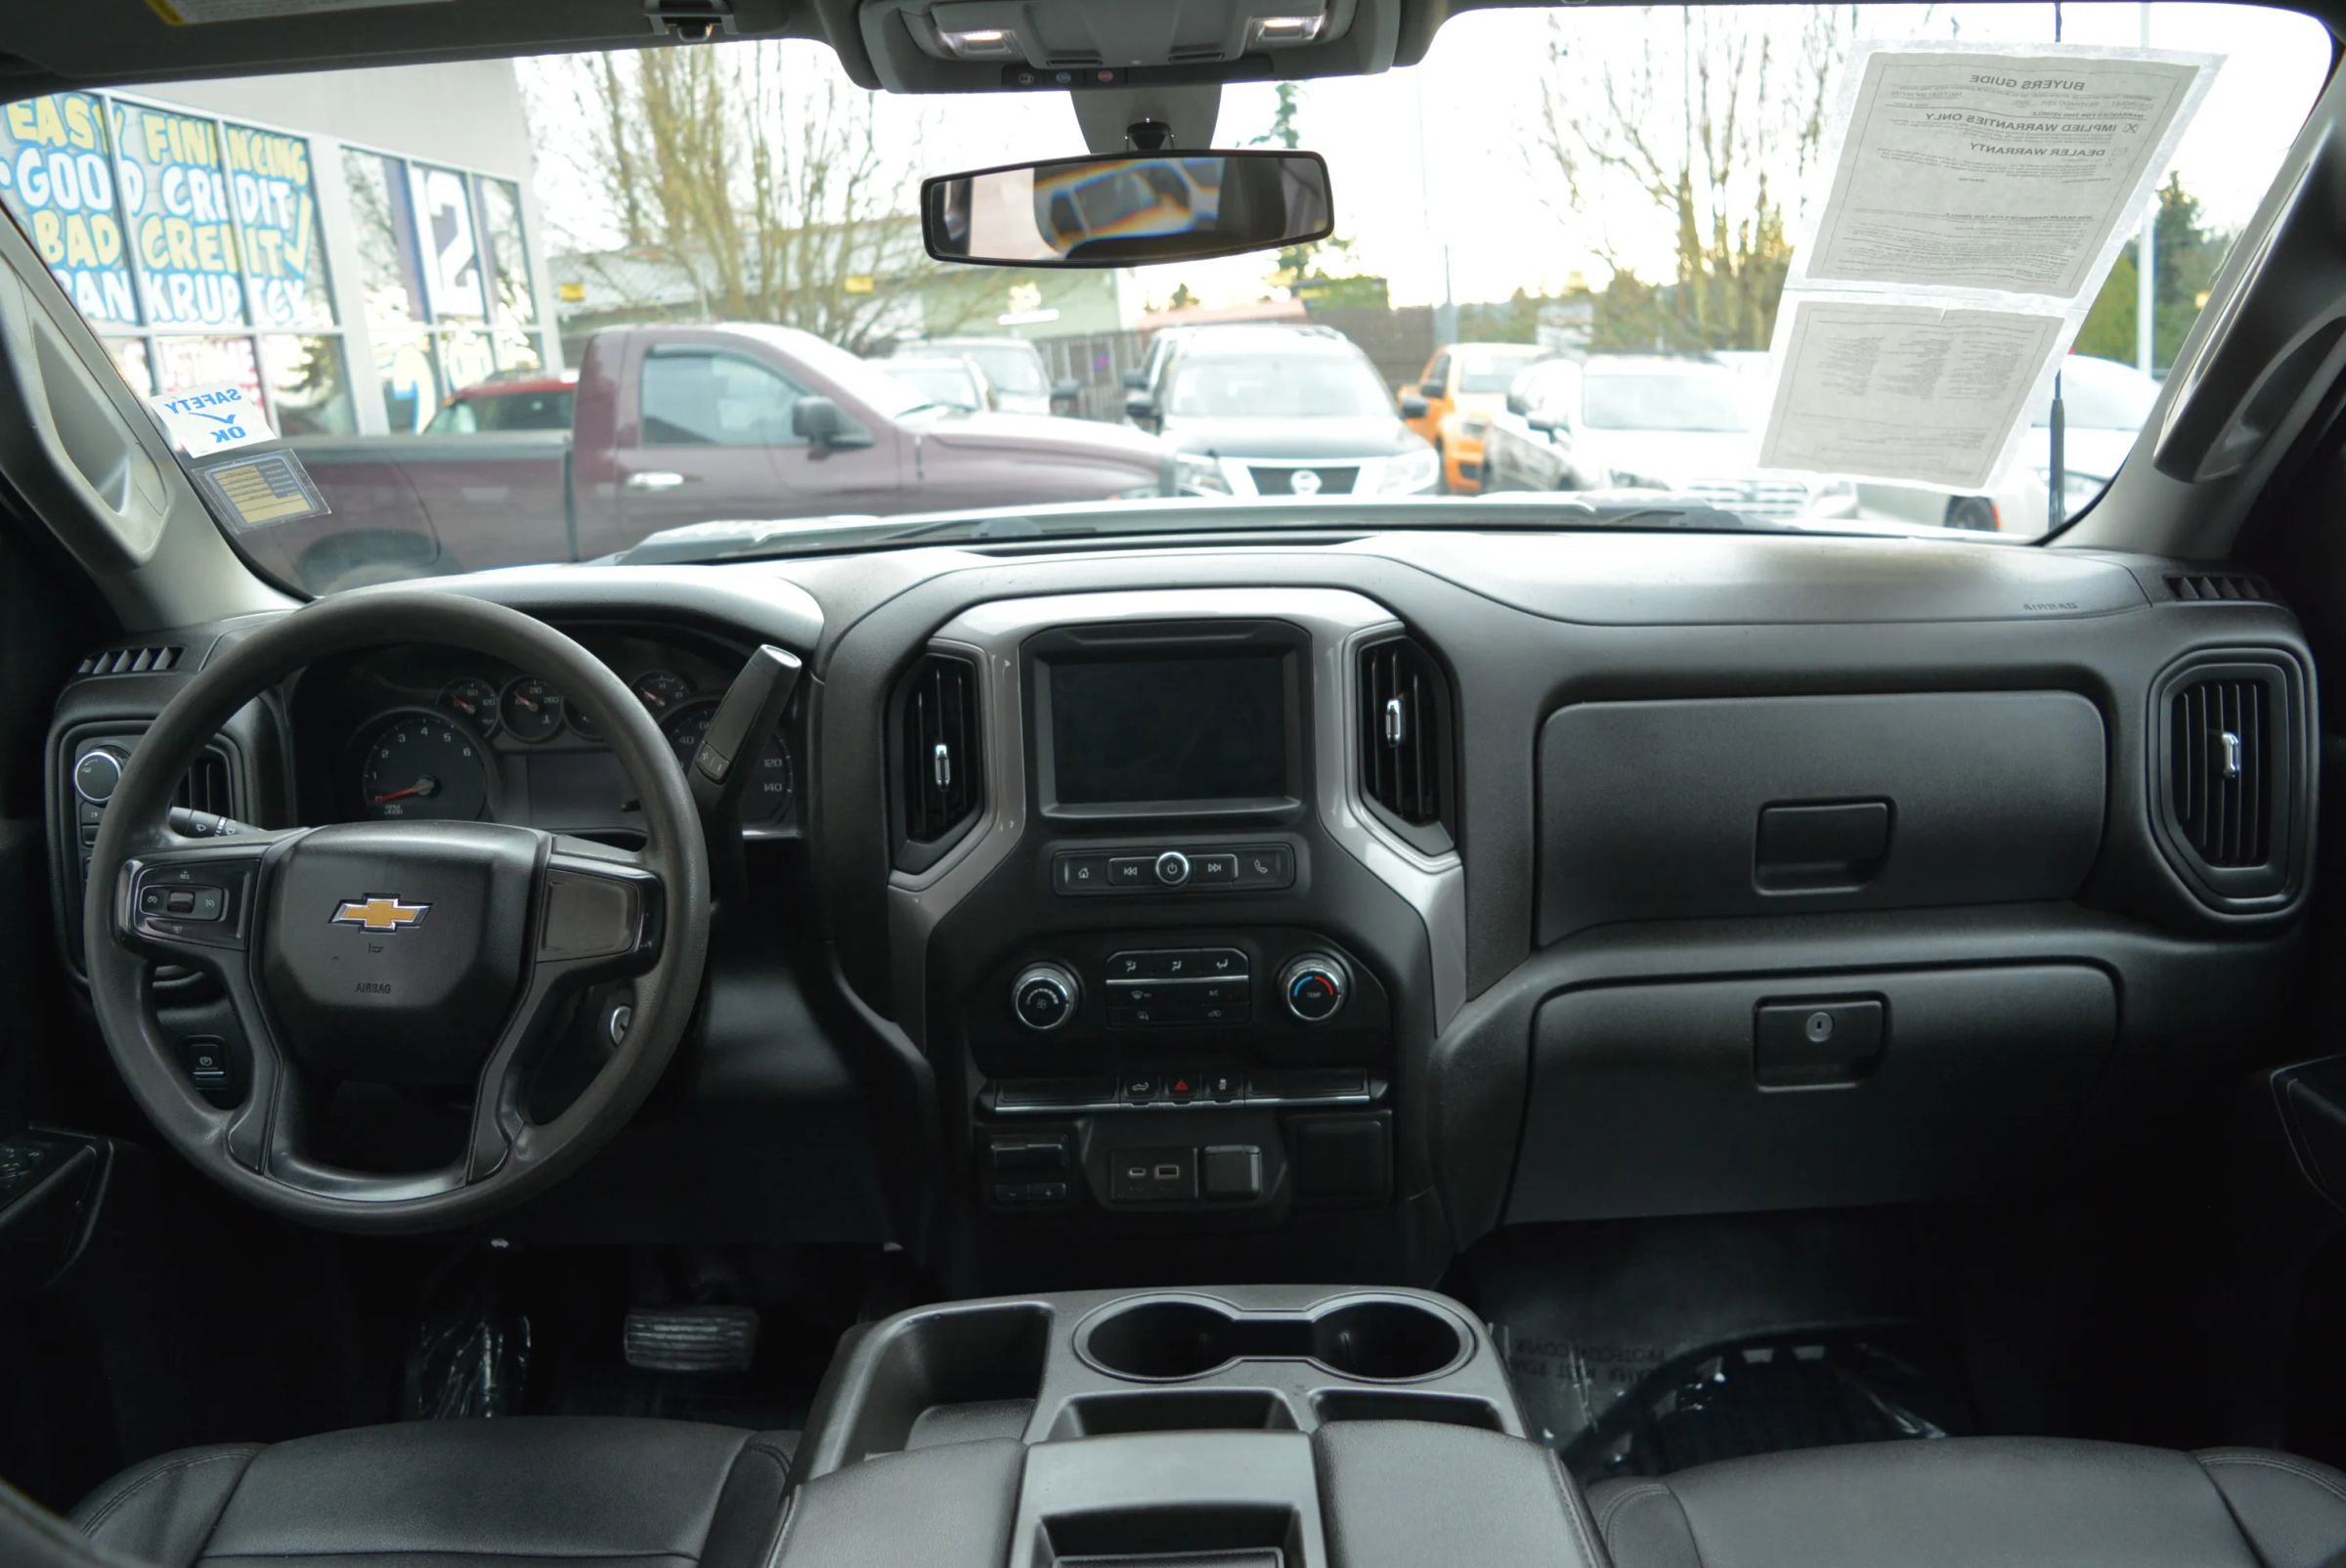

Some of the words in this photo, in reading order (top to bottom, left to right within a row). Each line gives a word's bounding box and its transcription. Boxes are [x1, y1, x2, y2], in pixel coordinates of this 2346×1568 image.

[143, 112, 308, 184] FINNCING
[16, 148, 145, 214] GOOD
[33, 209, 120, 267] BAD
[420, 726, 428, 735] 4
[398, 733, 406, 743] 3
[443, 732, 452, 742] 5
[462, 747, 471, 757] 6
[763, 758, 783, 767] 120
[763, 783, 783, 793] 140
[354, 982, 391, 994] AIRBAG
